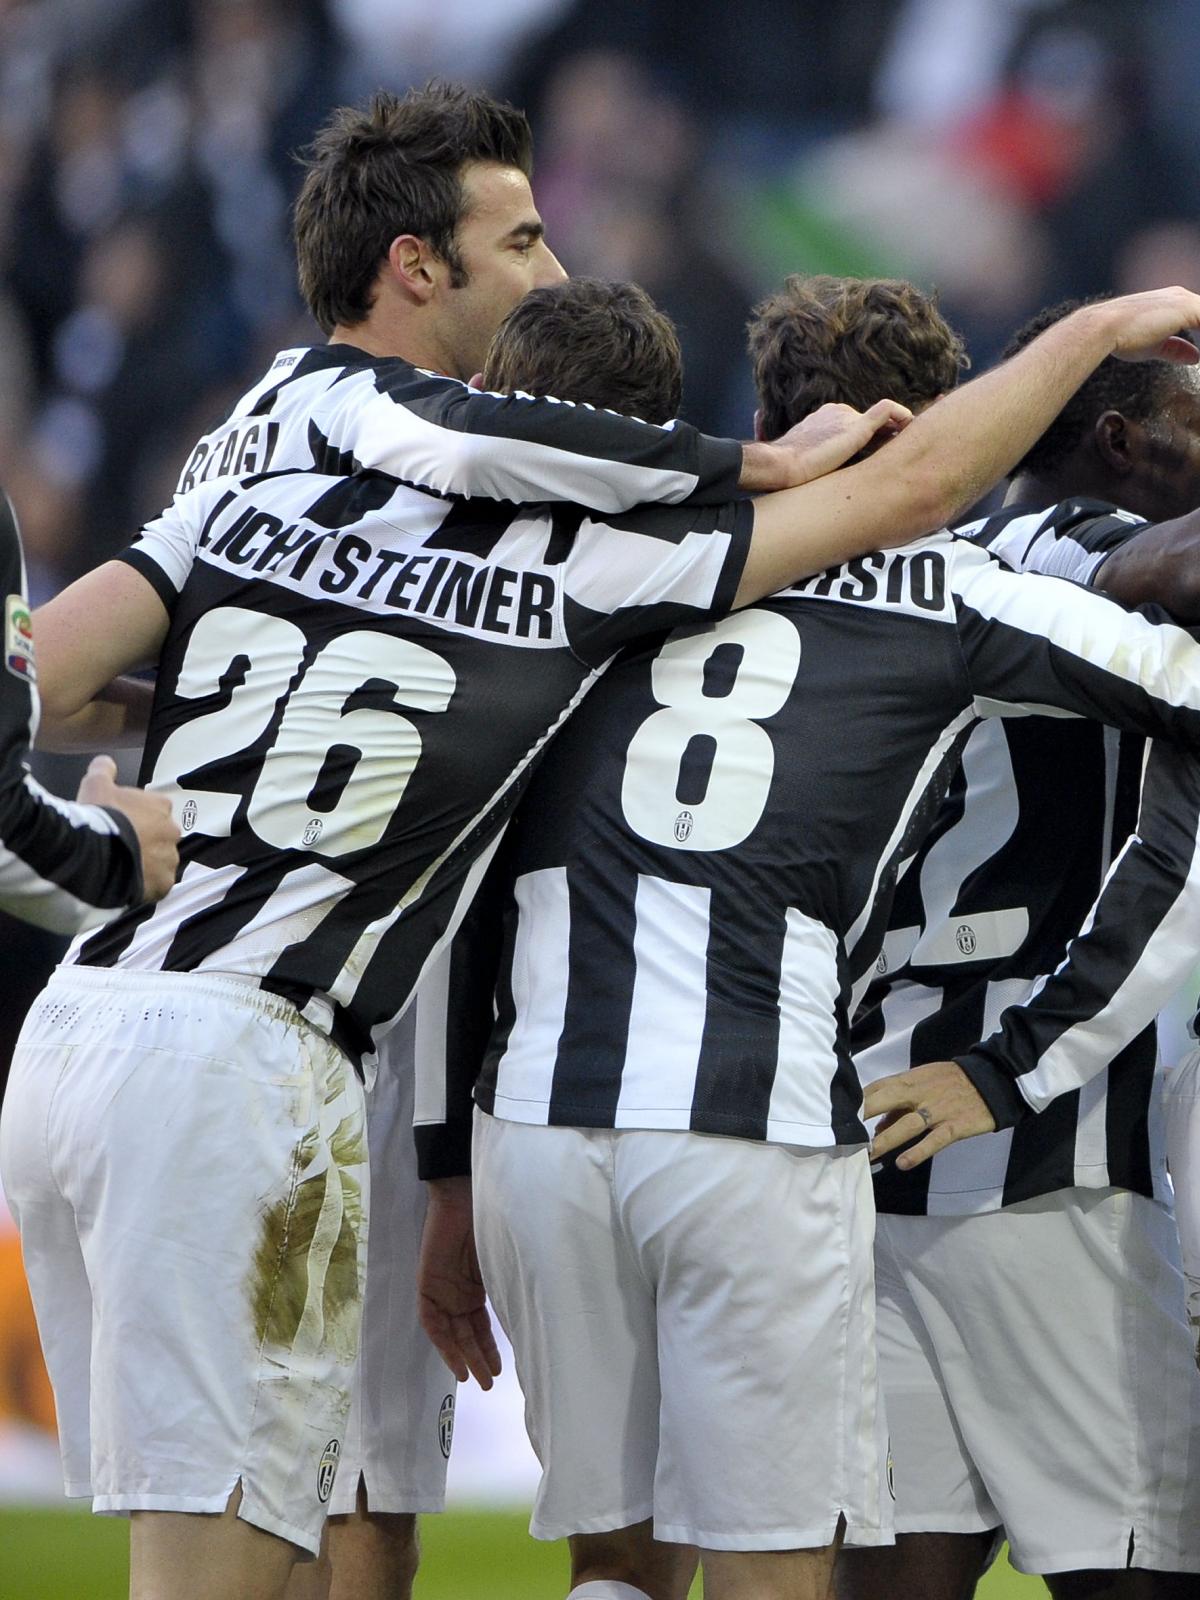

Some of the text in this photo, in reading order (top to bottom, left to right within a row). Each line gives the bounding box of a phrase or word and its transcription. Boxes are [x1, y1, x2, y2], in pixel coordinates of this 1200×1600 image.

[199, 489, 556, 640] LICHTSTEINER
[143, 606, 457, 858] 26
[621, 608, 801, 852] 8
